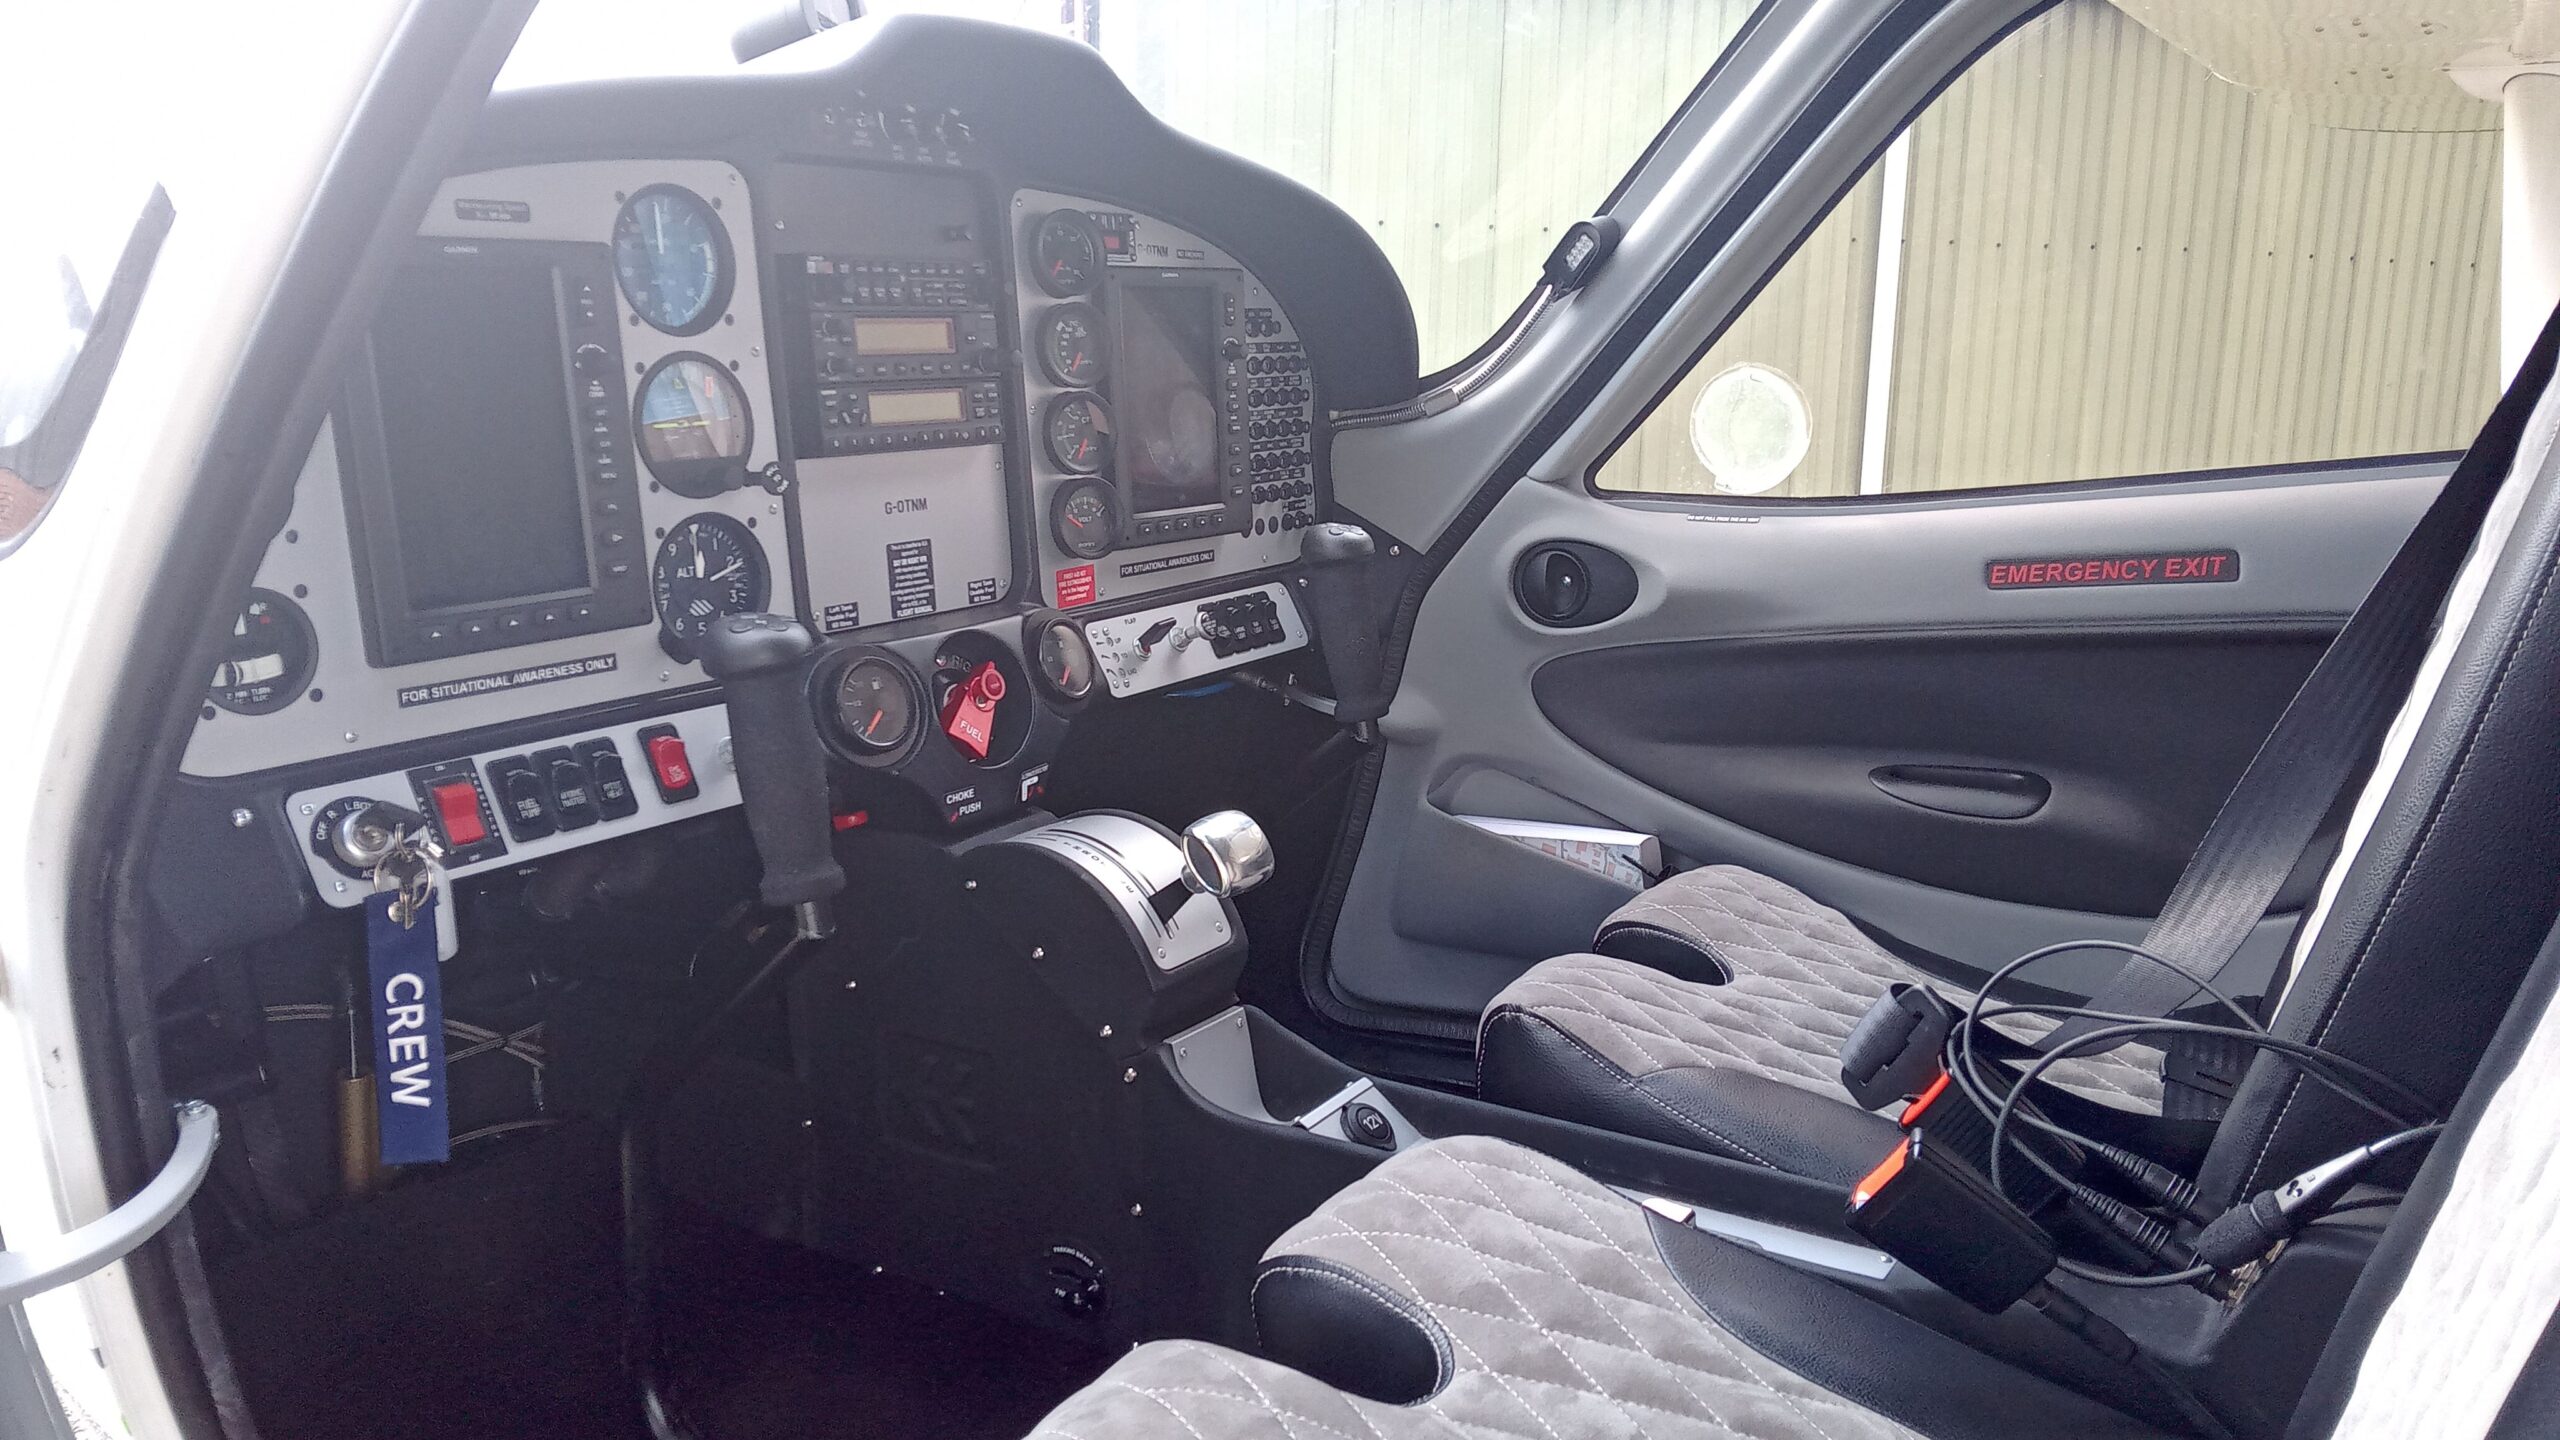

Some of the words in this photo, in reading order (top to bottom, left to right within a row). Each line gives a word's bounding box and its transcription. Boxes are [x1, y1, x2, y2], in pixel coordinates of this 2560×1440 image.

[885, 497, 928, 515] G-OTNM
[677, 566, 694, 579] ALT
[1121, 566, 1134, 576] FOR
[1133, 560, 1167, 574] SITUATIONAL
[1168, 554, 1200, 567] AWARENESS
[1199, 552, 1214, 561] ONLY
[1990, 558, 2157, 585] EMERGENCY
[2164, 555, 2227, 578] EXIT
[675, 618, 684, 631] 6
[401, 687, 431, 704] FOR
[430, 675, 511, 699] SITUATIONAL
[512, 662, 584, 684] AWARENESS
[585, 656, 615, 672] ONLY
[960, 720, 984, 743] FUEL
[946, 788, 976, 805] CHOKE
[959, 801, 983, 817] PUSH
[316, 821, 328, 841] OFF
[385, 973, 432, 1108] CREW
[1363, 1112, 1383, 1131] 12V
